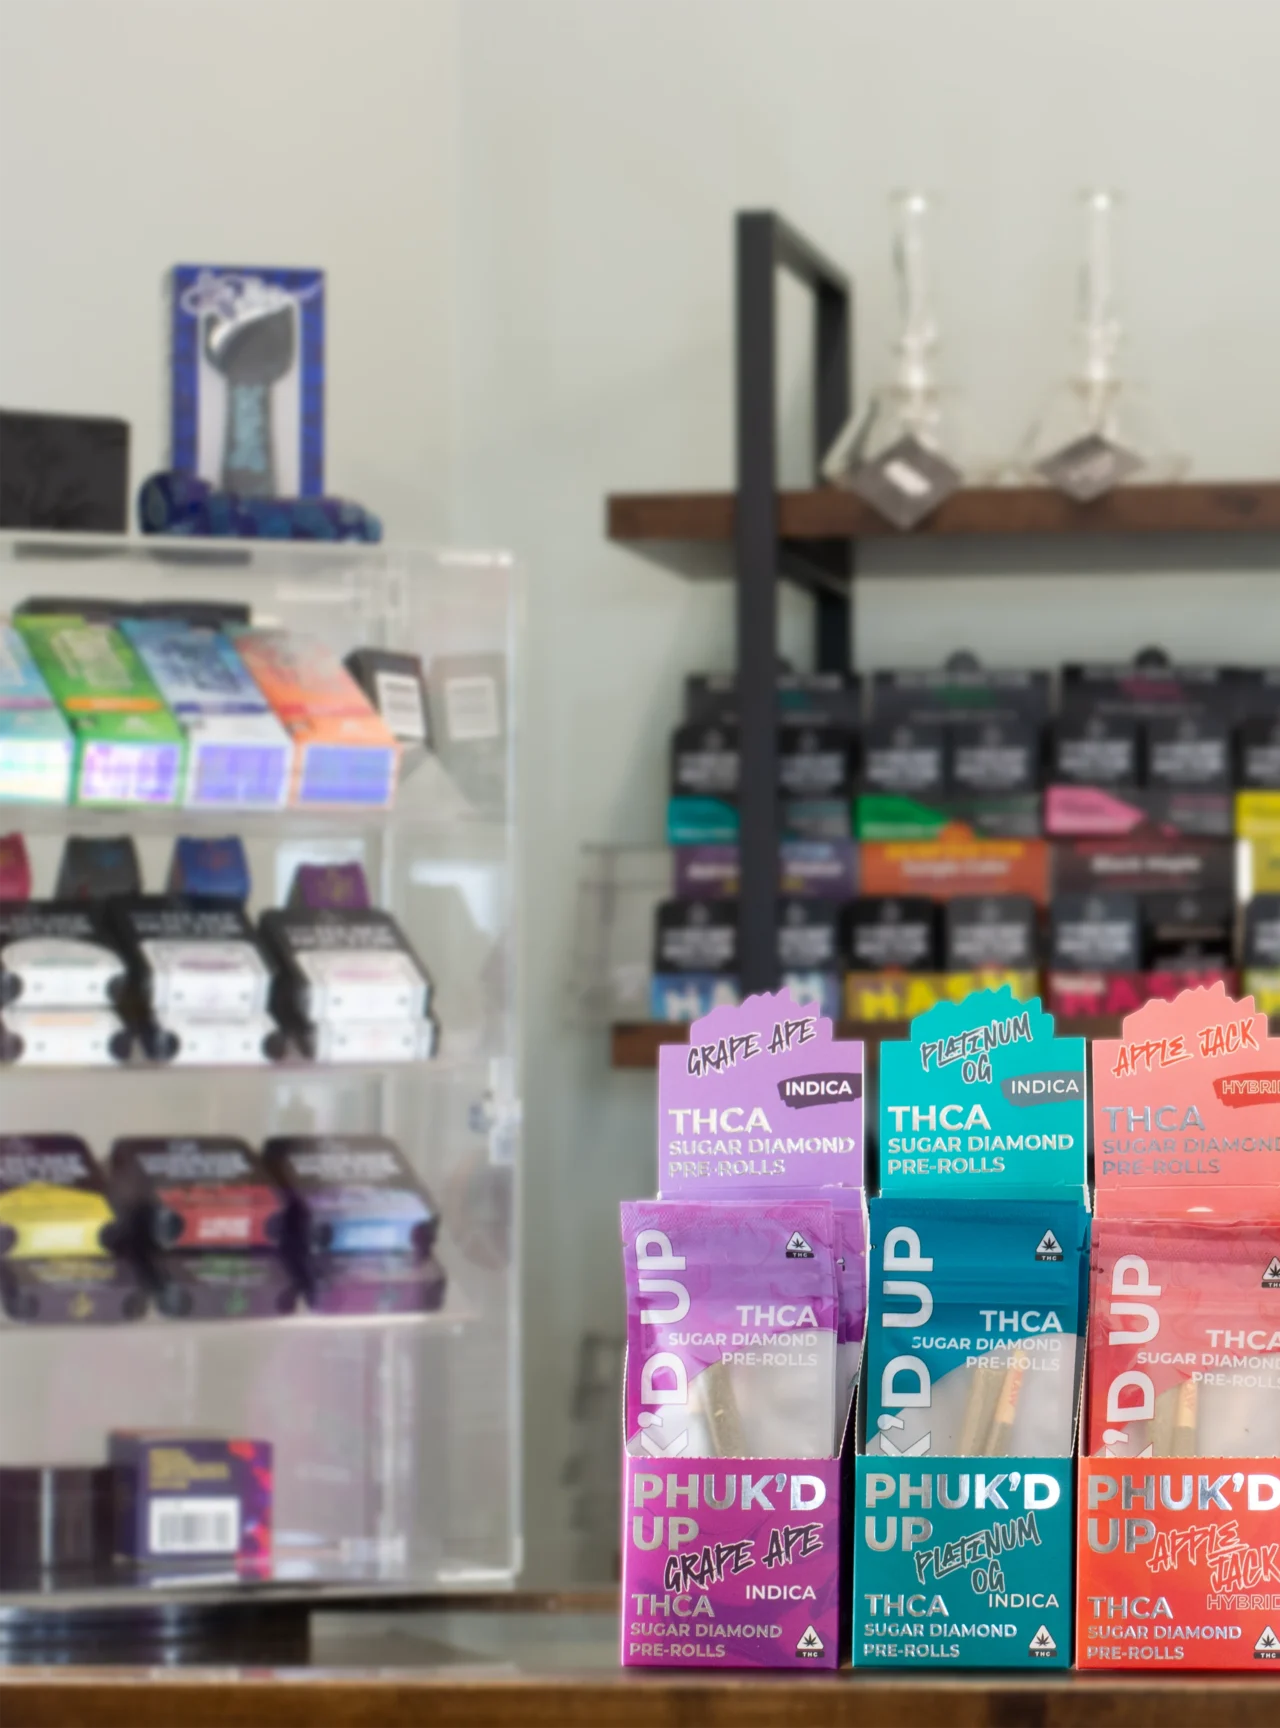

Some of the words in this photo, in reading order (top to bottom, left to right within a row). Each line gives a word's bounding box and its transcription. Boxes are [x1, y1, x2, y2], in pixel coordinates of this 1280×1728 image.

[686, 1032, 761, 1077] GRAPE
[767, 1016, 817, 1056] APE
[920, 1011, 1033, 1073] PLATINUM
[1111, 1034, 1194, 1079] APPLE
[1197, 1017, 1260, 1058] JACK
[962, 1052, 993, 1084] OG
[785, 1080, 852, 1096] INDICA
[1011, 1079, 1079, 1094] INDICA
[668, 1107, 772, 1135] THCA
[888, 1104, 991, 1132] THCA
[1102, 1105, 1206, 1133] THCA
[668, 1139, 742, 1157] SUGAR
[748, 1136, 855, 1154] DIAMOND
[888, 1136, 962, 1154] SUGAR
[968, 1134, 1074, 1152] DIAMOND
[1103, 1137, 1176, 1155] SUGAR
[668, 1159, 786, 1178] PRE-ROLLS
[888, 1156, 1005, 1175] PRE-ROLLS
[1102, 1158, 1221, 1175] PRE-ROLLS
[635, 1228, 691, 1324] UP
[882, 1226, 934, 1328] UP
[1109, 1254, 1162, 1346] UP
[736, 1305, 818, 1328] THCA
[979, 1310, 1063, 1332] THCA
[668, 1332, 726, 1346] SUGAR
[731, 1333, 818, 1347] DIAMOND
[911, 1336, 971, 1350] SUGAR
[976, 1338, 1062, 1352] DIAMOND
[722, 1352, 818, 1367] PRE-ROLLS
[966, 1356, 1060, 1371] PRE-ROLLS
[1136, 1352, 1197, 1365] SUGAR
[633, 1473, 827, 1511] PHUK'D
[865, 1471, 1061, 1510] PHUK'D
[632, 1516, 700, 1551] UP
[864, 1516, 933, 1551] UP
[1087, 1518, 1156, 1554] UP
[664, 1539, 755, 1594] GRAPE
[761, 1522, 824, 1569] APE
[913, 1511, 1042, 1585] PLATINUM
[1145, 1519, 1250, 1574] APPLE
[971, 1559, 1005, 1595] OG
[745, 1585, 817, 1600] INDICA
[988, 1594, 1060, 1608] INDICA
[631, 1594, 715, 1618] THCA
[864, 1594, 949, 1617] THCA
[1087, 1596, 1174, 1619] THCA
[630, 1622, 690, 1637] SUGAR
[695, 1624, 783, 1639] DIAMOND
[864, 1623, 925, 1637] SUGAR
[929, 1624, 1017, 1638] DIAMOND
[1087, 1625, 1149, 1640] SUGAR
[1153, 1625, 1242, 1640] DIAMOND
[629, 1643, 726, 1658] PRE-ROLLS
[863, 1643, 960, 1658] PRE-ROLLS
[1087, 1646, 1185, 1661] PRE-ROLLS
